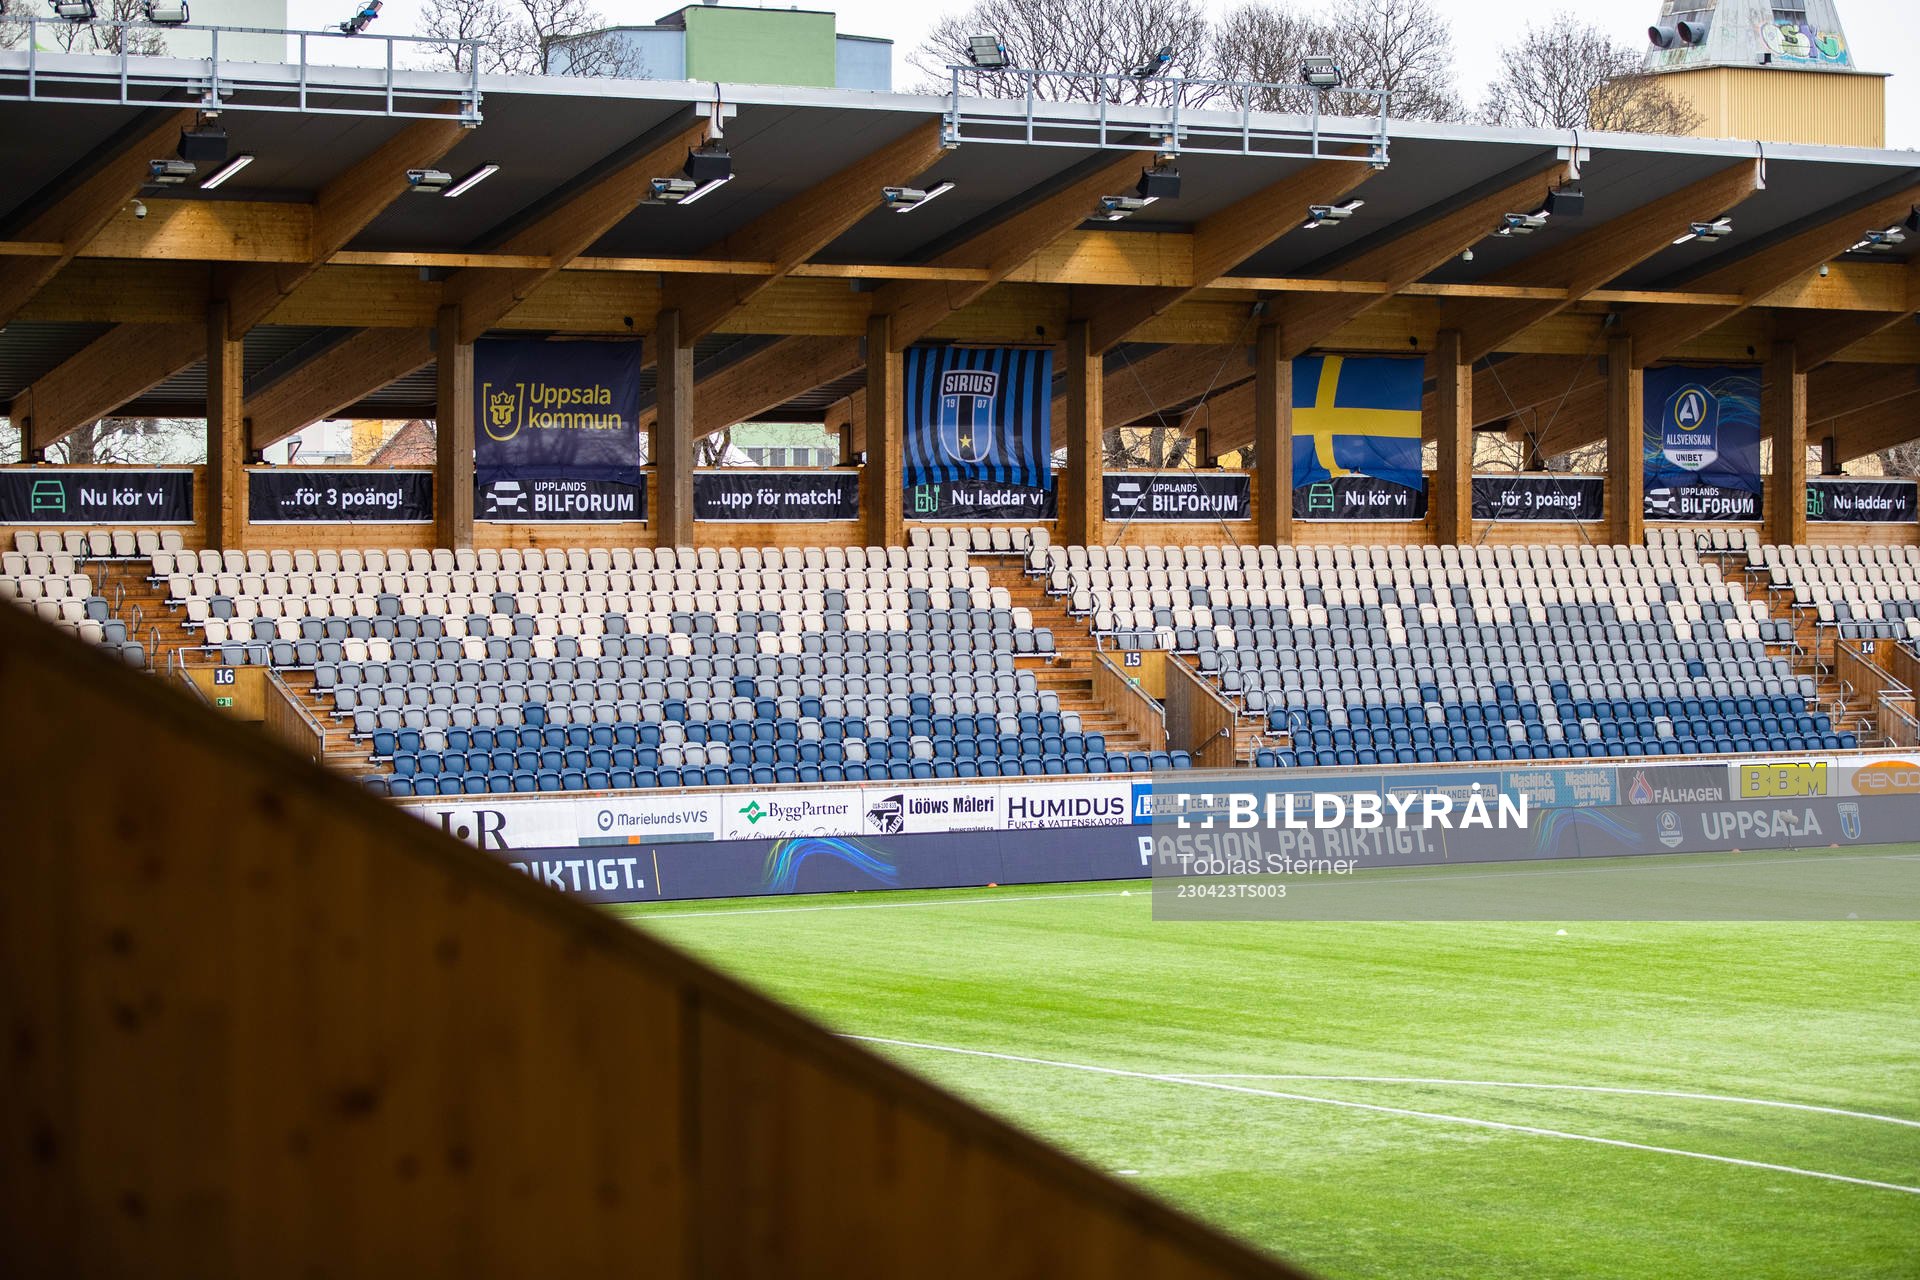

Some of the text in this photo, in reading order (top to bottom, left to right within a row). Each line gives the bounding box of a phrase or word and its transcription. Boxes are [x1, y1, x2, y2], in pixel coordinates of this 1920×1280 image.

[945, 374, 993, 393] SIRIUS
[530, 383, 611, 407] Uppsala
[946, 399, 987, 408] 19 07
[529, 406, 622, 430] kommun
[1667, 434, 1711, 445] ALLSVENSKAN
[1676, 454, 1703, 462] UNIBET
[535, 482, 586, 491] UPPLANDS
[1152, 483, 1197, 492] UPPLANDS
[1681, 488, 1719, 496] UPPLANDS
[81, 487, 163, 505] Nu kör vi
[281, 488, 403, 510] ...för 3 poäng!
[535, 494, 634, 512] BILFORUM
[708, 489, 841, 509] ...upp för match!
[952, 489, 1044, 506] Nu laddar vi
[1152, 495, 1238, 512] BILFORUM
[1345, 490, 1407, 506] Nu kör vi
[1490, 491, 1582, 511] ...för 3 poäng!
[1833, 495, 1905, 510] Nu laddar vi
[1682, 498, 1754, 513] BILFORUM
[1862, 642, 1874, 653] 14
[1126, 653, 1140, 666] 15
[217, 669, 233, 683] 16
[1740, 762, 1828, 798] BBM
[1655, 788, 1722, 803] FÅLHAGEN
[769, 801, 848, 821] ByggPartner
[909, 795, 994, 814] Lööws Måleri
[1008, 797, 1124, 818] HUMIDUS
[1008, 818, 1124, 829] FUKT- & VATTENSKADOR
[1701, 808, 1822, 840] UPPSALA
[1137, 824, 1434, 866] PASSION. PÅ RIKTIGT.
